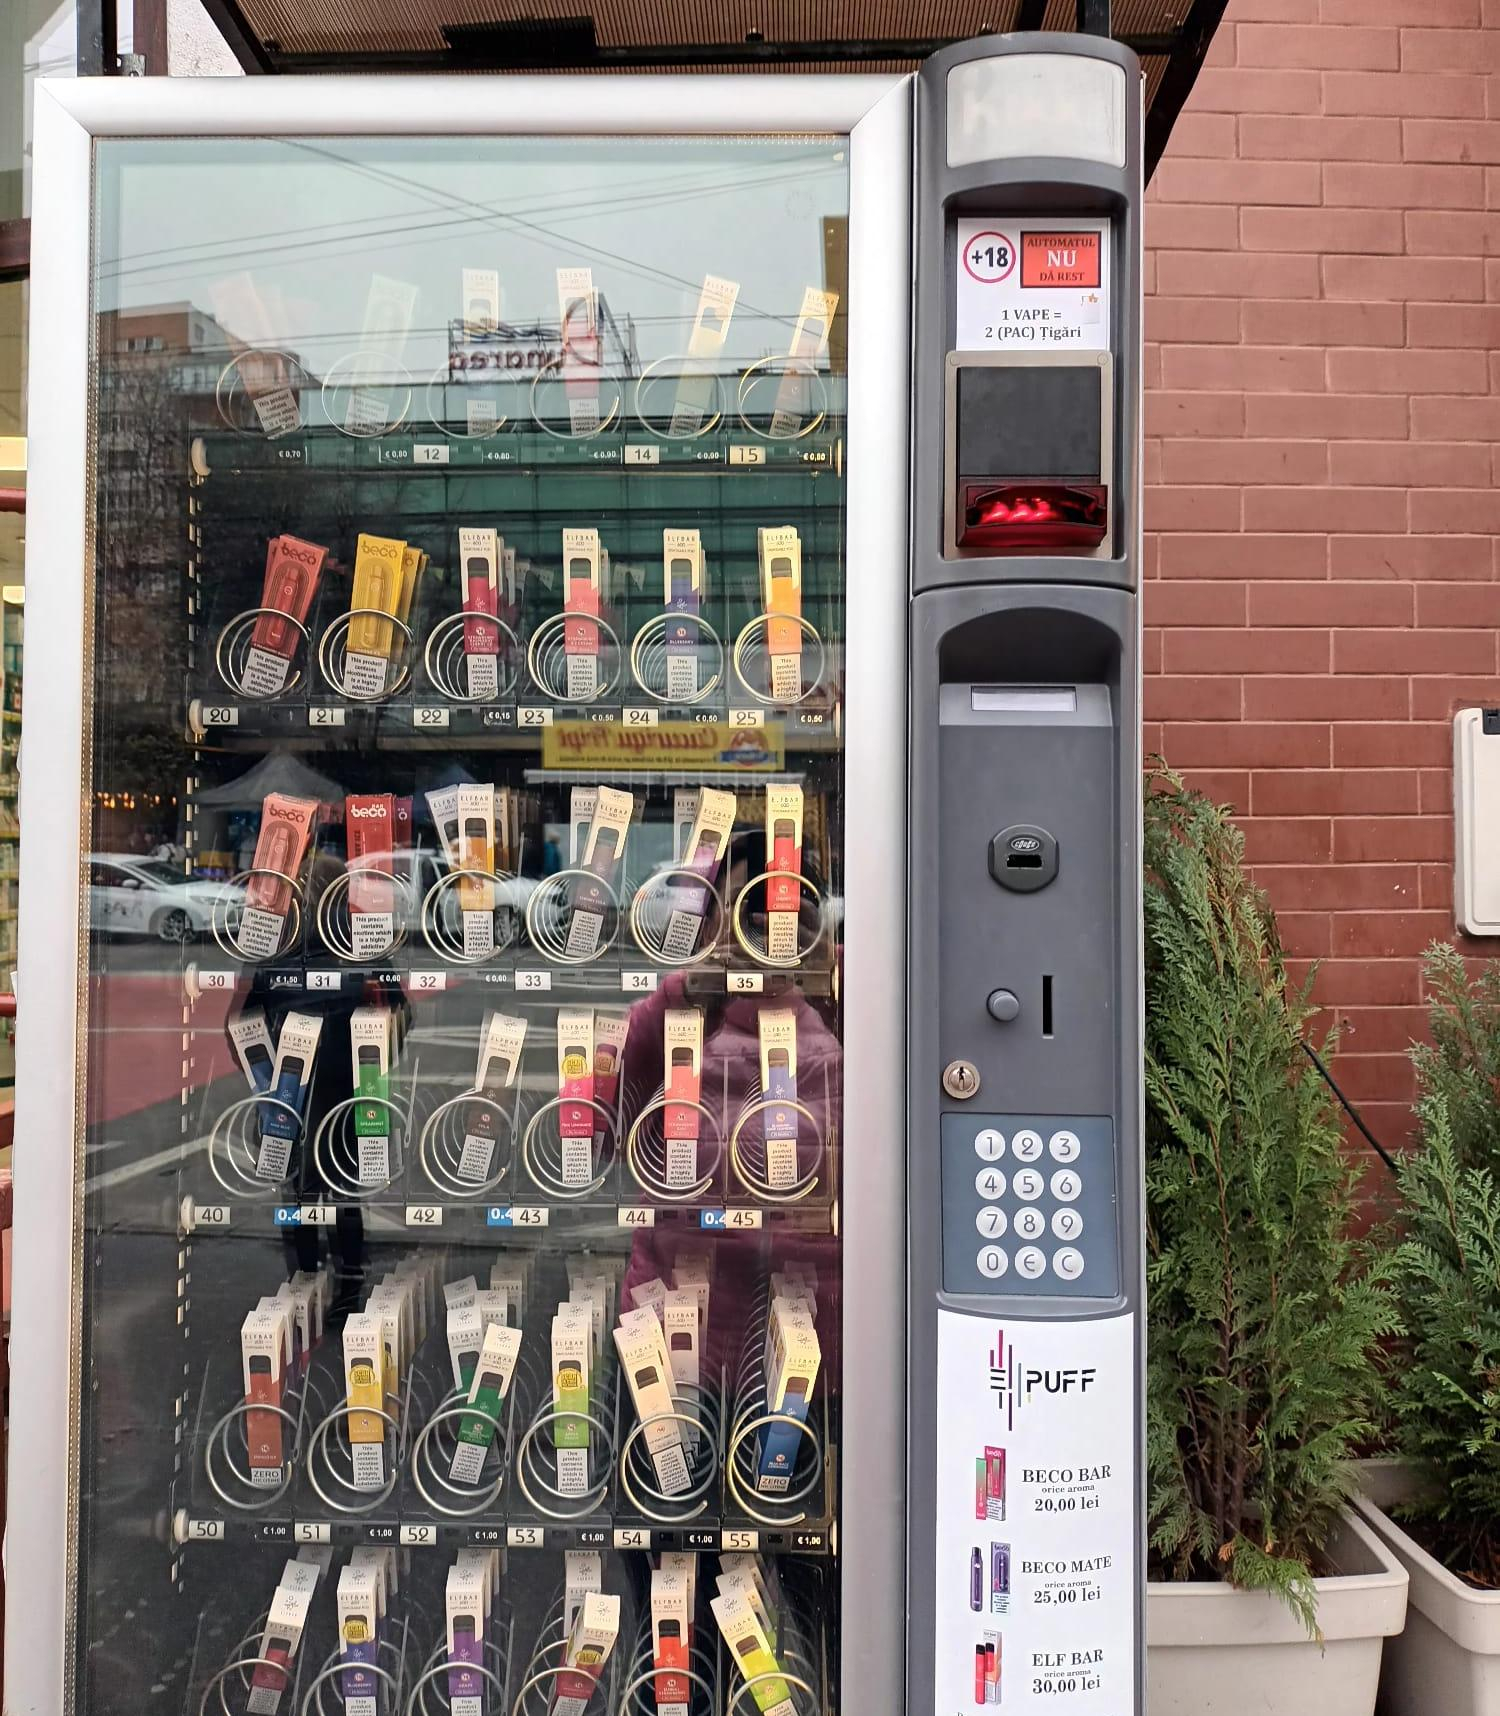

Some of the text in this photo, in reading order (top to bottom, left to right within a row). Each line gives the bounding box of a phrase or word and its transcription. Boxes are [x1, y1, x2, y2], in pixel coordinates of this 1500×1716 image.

[1027, 238, 1095, 247] AUTOMATUL
[972, 247, 1008, 267] +18
[1047, 250, 1076, 267] NU
[1058, 272, 1085, 281] REST
[1002, 310, 1010, 321] 1
[1014, 309, 1050, 321] VAPE
[984, 326, 993, 338] 2
[998, 326, 1035, 340] (PAC)
[424, 448, 440, 461] 12
[634, 450, 651, 461] 14
[739, 448, 757, 463] 15
[210, 708, 231, 723] 20
[316, 710, 335, 723] 21
[422, 710, 442, 724] 22
[525, 710, 545, 724] 23
[630, 711, 650, 725] 24
[736, 712, 757, 726] 25
[208, 976, 225, 987] 30
[315, 976, 331, 987] 31
[420, 976, 436, 988] 32
[525, 976, 542, 987] 33
[632, 976, 649, 988] 34
[737, 978, 754, 989] 35
[986, 1136, 993, 1155] 1
[1021, 1137, 1034, 1156] 2
[1059, 1138, 1071, 1156] 3
[984, 1174, 998, 1193] 4
[1022, 1176, 1035, 1194] 5
[1060, 1176, 1073, 1195] 6
[202, 1208, 224, 1222] 40
[308, 1208, 327, 1222] 41
[414, 1209, 435, 1223] 42
[519, 1209, 541, 1224] 43
[625, 1211, 647, 1225] 44
[733, 1212, 754, 1226] 45
[986, 1213, 999, 1232] 7
[1024, 1214, 1036, 1233] 8
[1061, 1215, 1074, 1233] 9
[1062, 1254, 1074, 1273] C
[1026, 1368, 1096, 1394] PUFF
[762, 1476, 787, 1485] ZERO
[1022, 1464, 1112, 1484] BECO BAR
[1041, 1484, 1095, 1493] orice aroma
[1034, 1495, 1100, 1513] 20,00 lei
[196, 1522, 218, 1537] 50
[302, 1526, 321, 1540] 51
[408, 1527, 429, 1542] 52
[515, 1529, 536, 1544] 53
[622, 1532, 642, 1546] 54
[730, 1533, 751, 1548] 55
[1022, 1556, 1112, 1574] BECO MATE
[1044, 1579, 1092, 1588] orice aroma
[1034, 1586, 1101, 1606] 25,00 lei
[1032, 1649, 1104, 1667] ELF BAR
[1044, 1669, 1092, 1678] orice aroma
[1032, 1675, 1101, 1695] 30,00 lei
